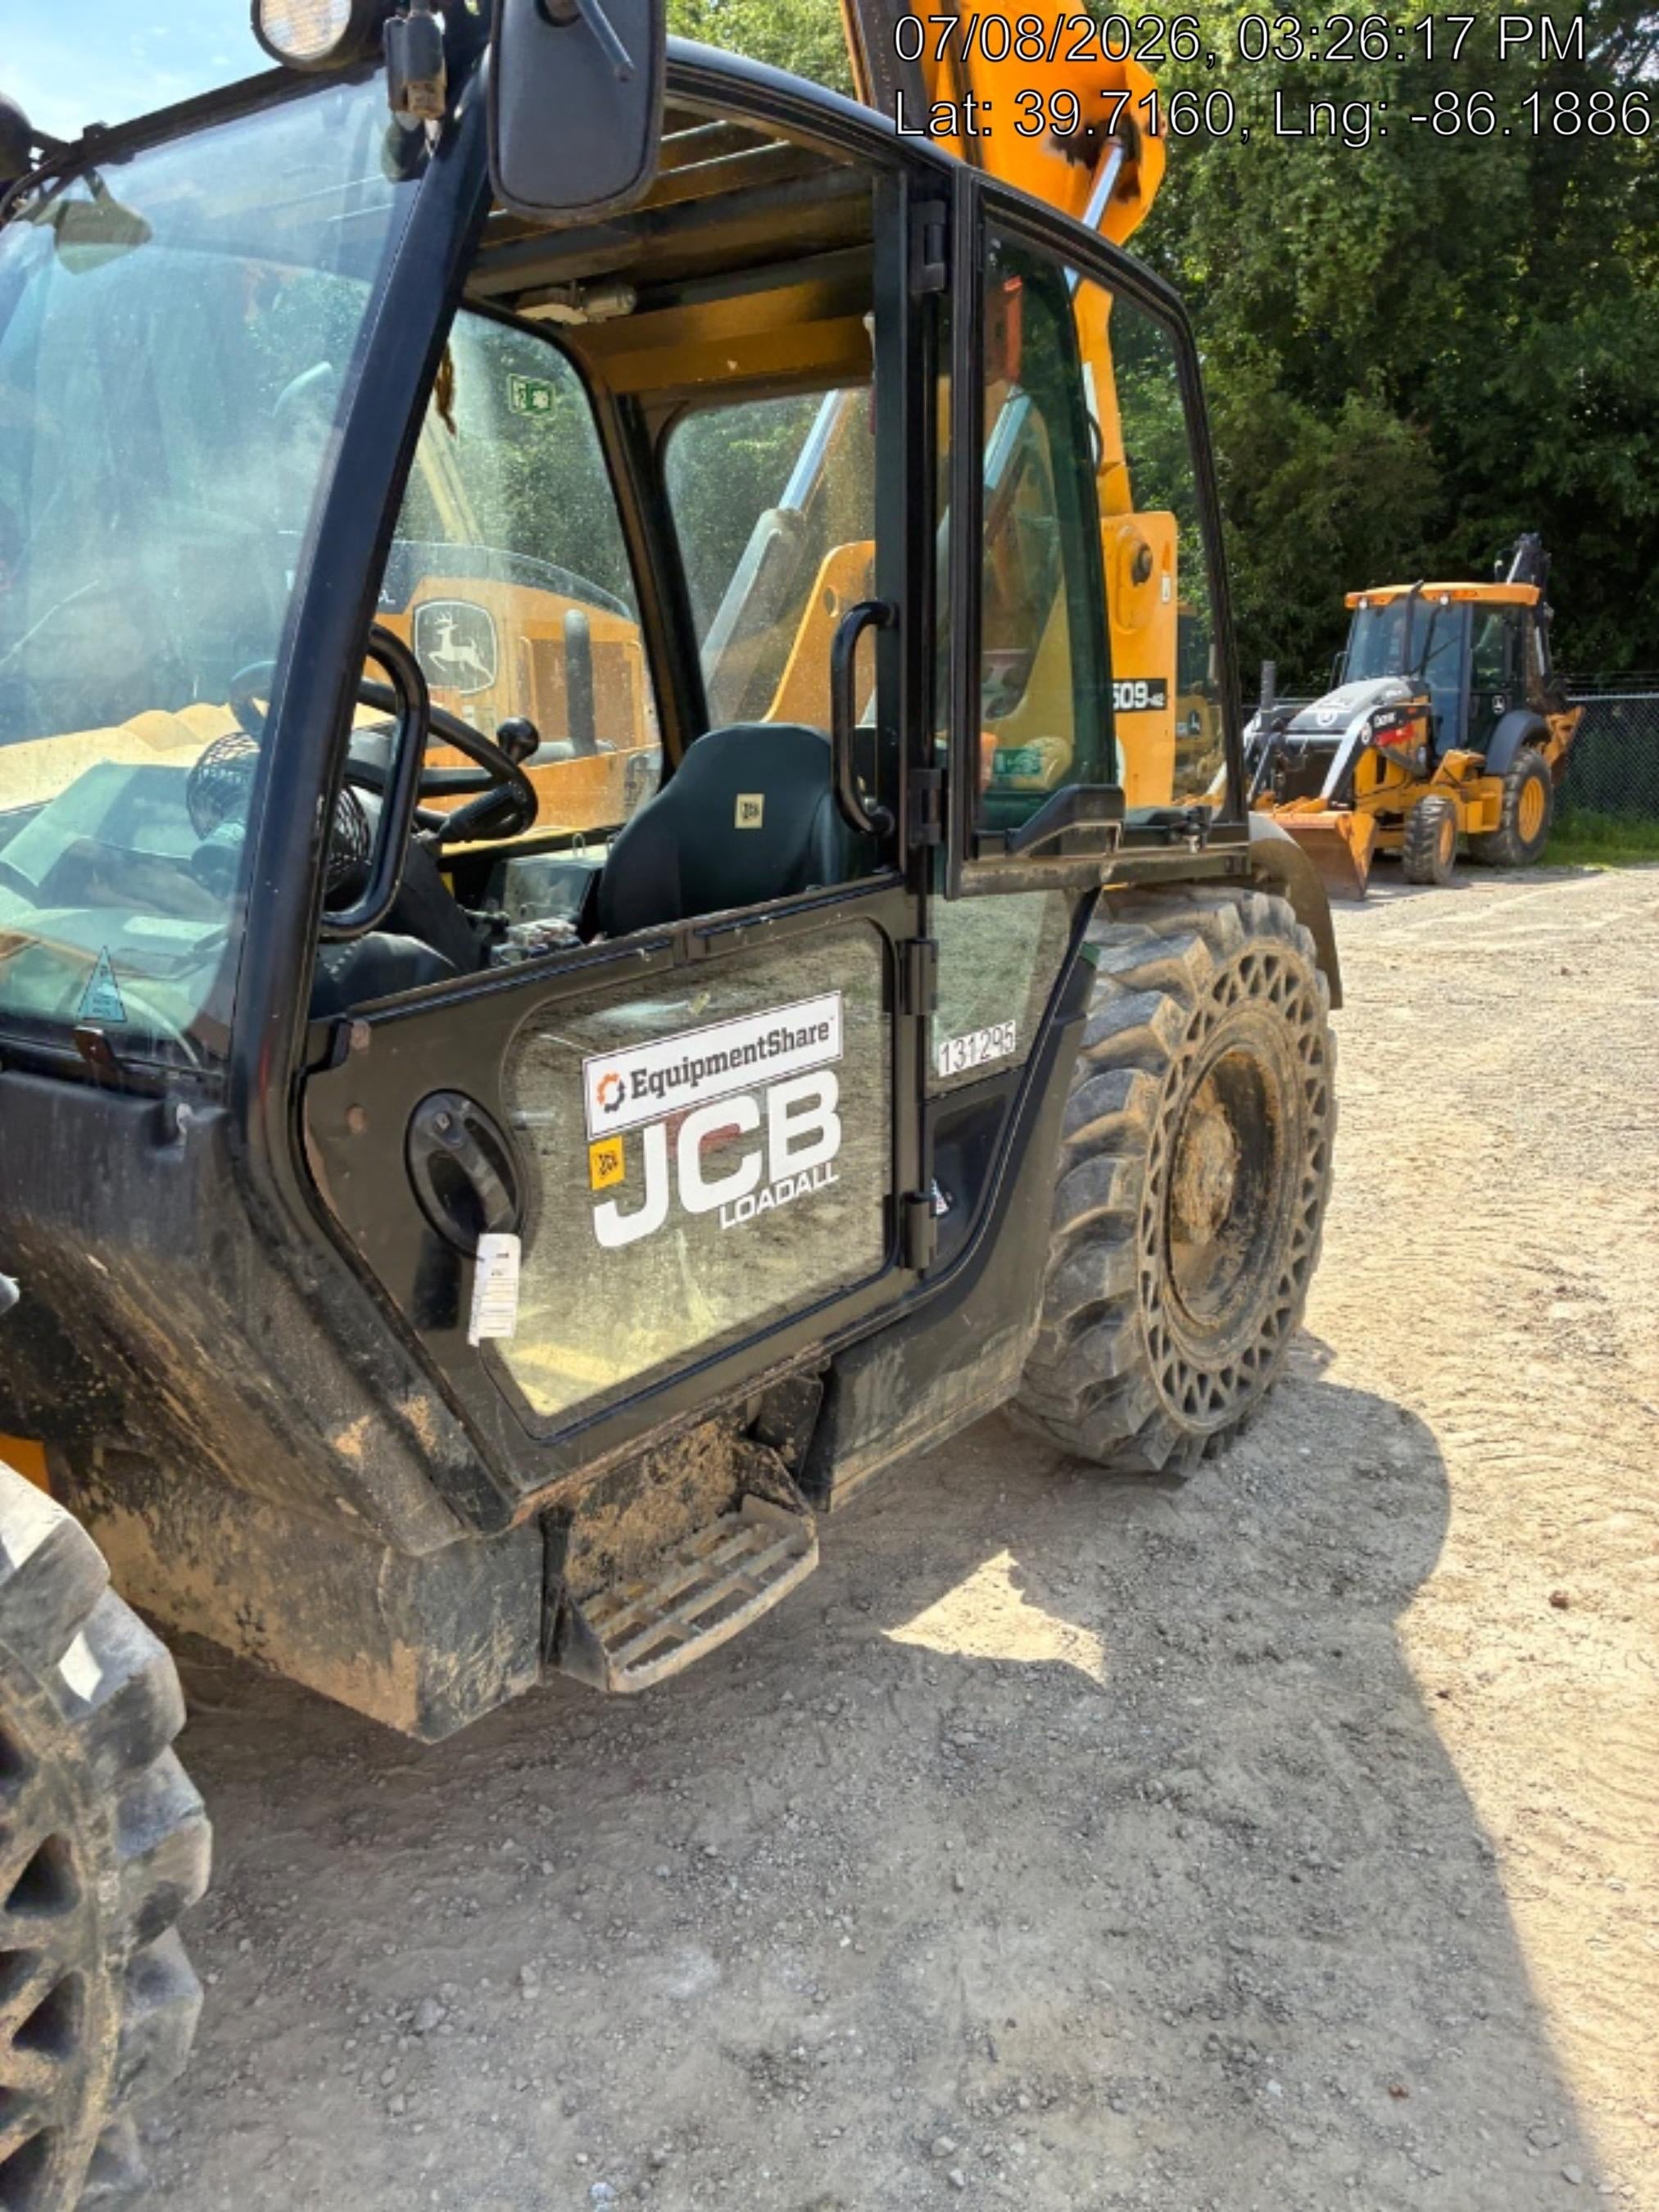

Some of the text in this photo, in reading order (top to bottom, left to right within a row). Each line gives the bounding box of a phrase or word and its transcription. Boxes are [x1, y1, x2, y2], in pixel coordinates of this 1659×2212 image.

[630, 1021, 829, 1099] EquipmentShare
[941, 1022, 1013, 1073] 131295
[594, 1070, 841, 1248] JCB
[719, 1161, 840, 1229] LOADALL
